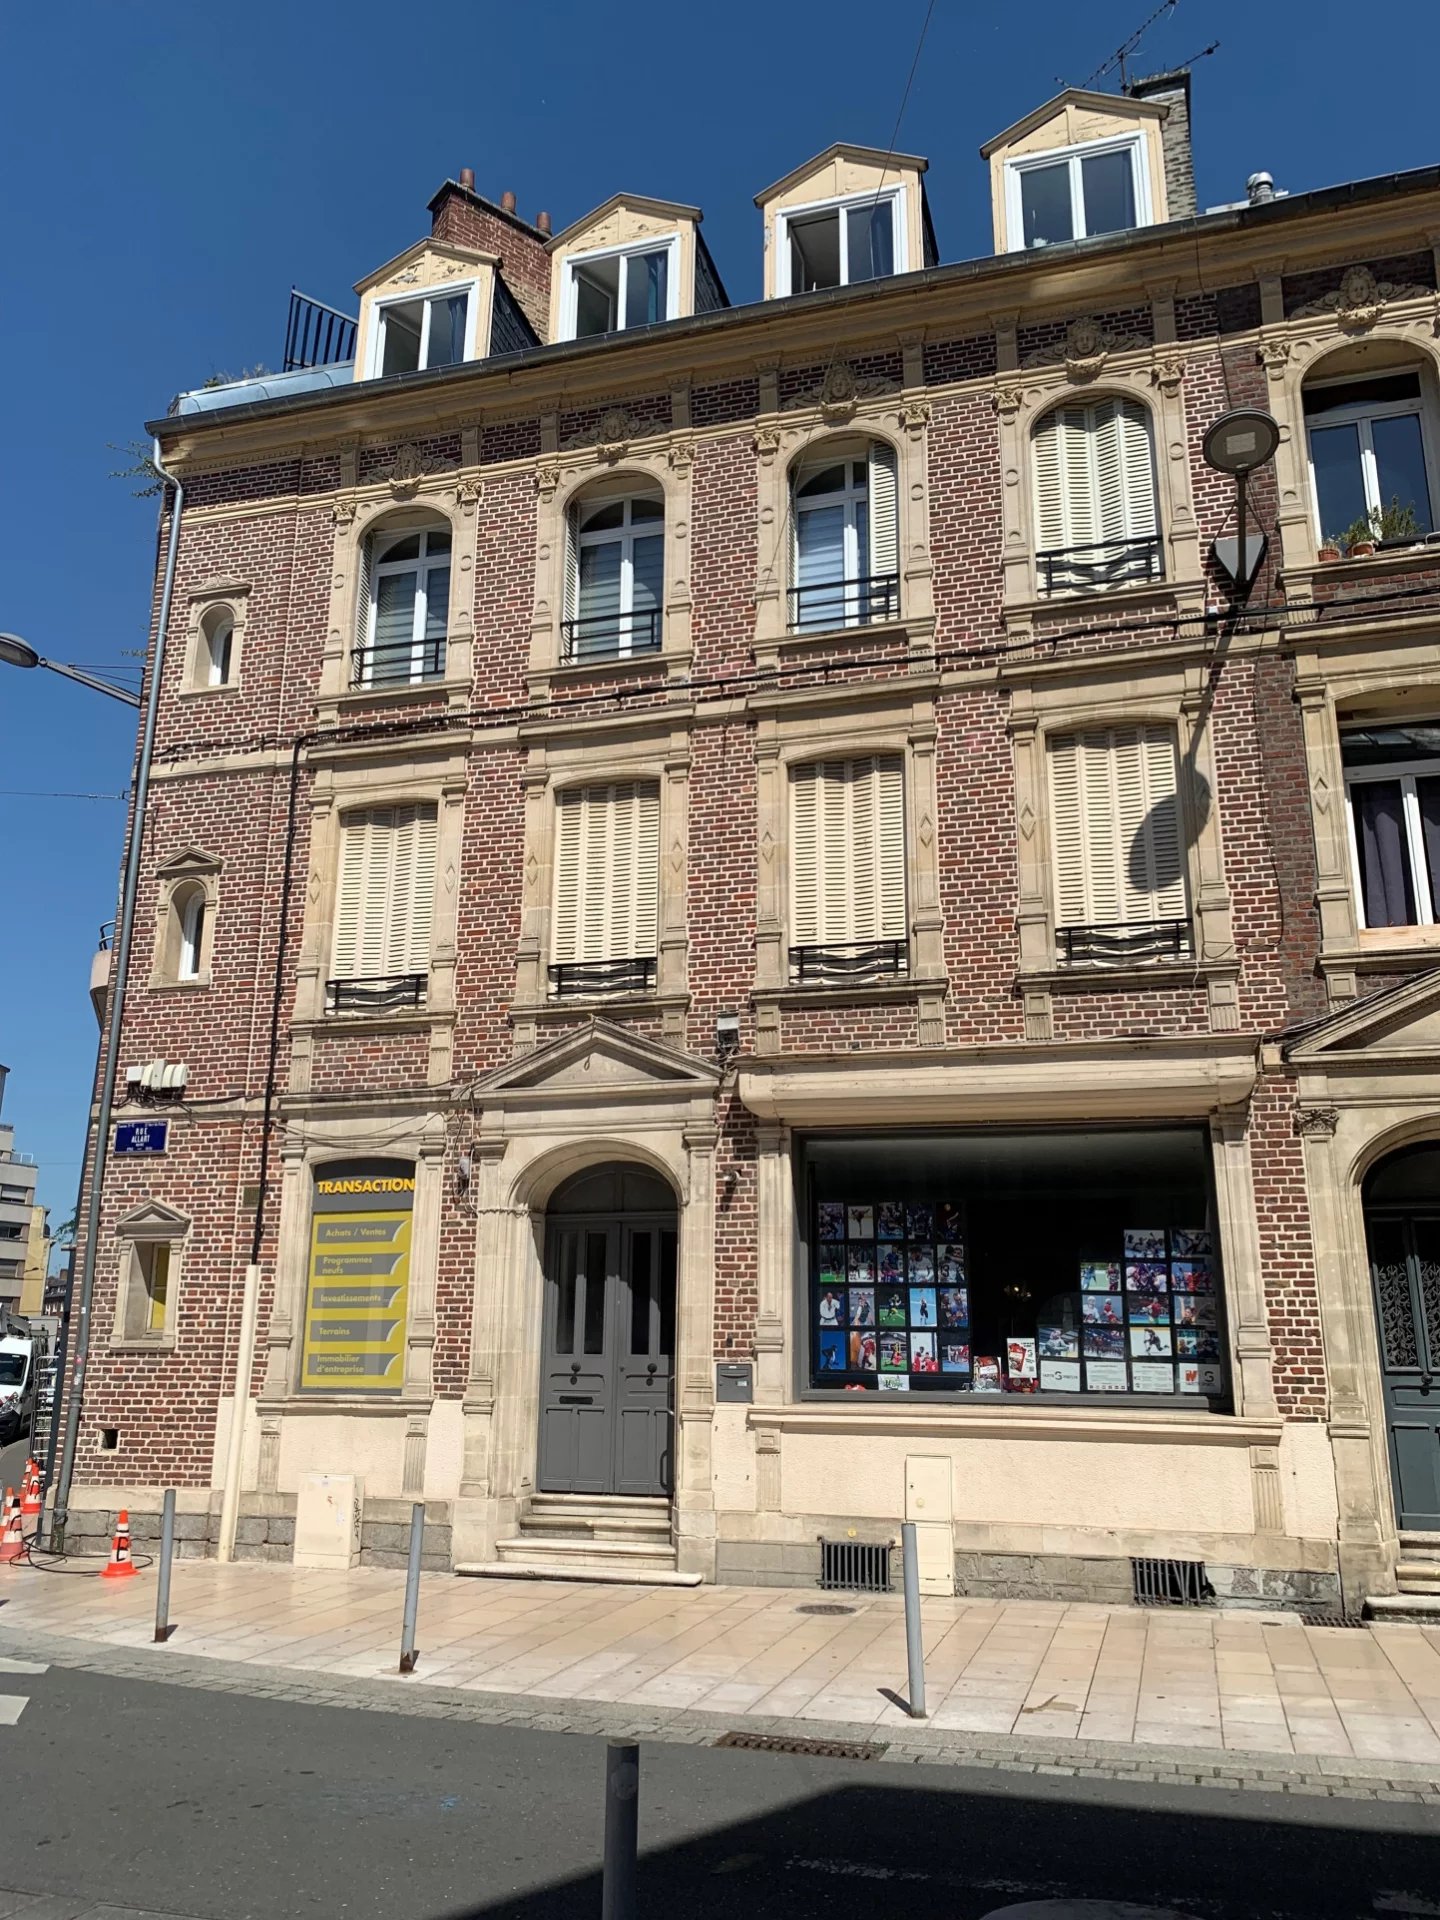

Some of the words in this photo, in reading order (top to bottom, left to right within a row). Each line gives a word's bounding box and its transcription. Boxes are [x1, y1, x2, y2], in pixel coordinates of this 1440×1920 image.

[317, 1178, 415, 1194] TRANSACTION
[325, 1228, 351, 1237] Achats
[360, 1227, 387, 1236] Ventes
[323, 1256, 372, 1267] Programmes
[322, 1266, 344, 1275] neufs
[320, 1293, 381, 1303] Investissements
[319, 1327, 350, 1336] Terrains
[316, 1355, 360, 1364] Immobilier
[316, 1365, 365, 1375] d'entreprise
